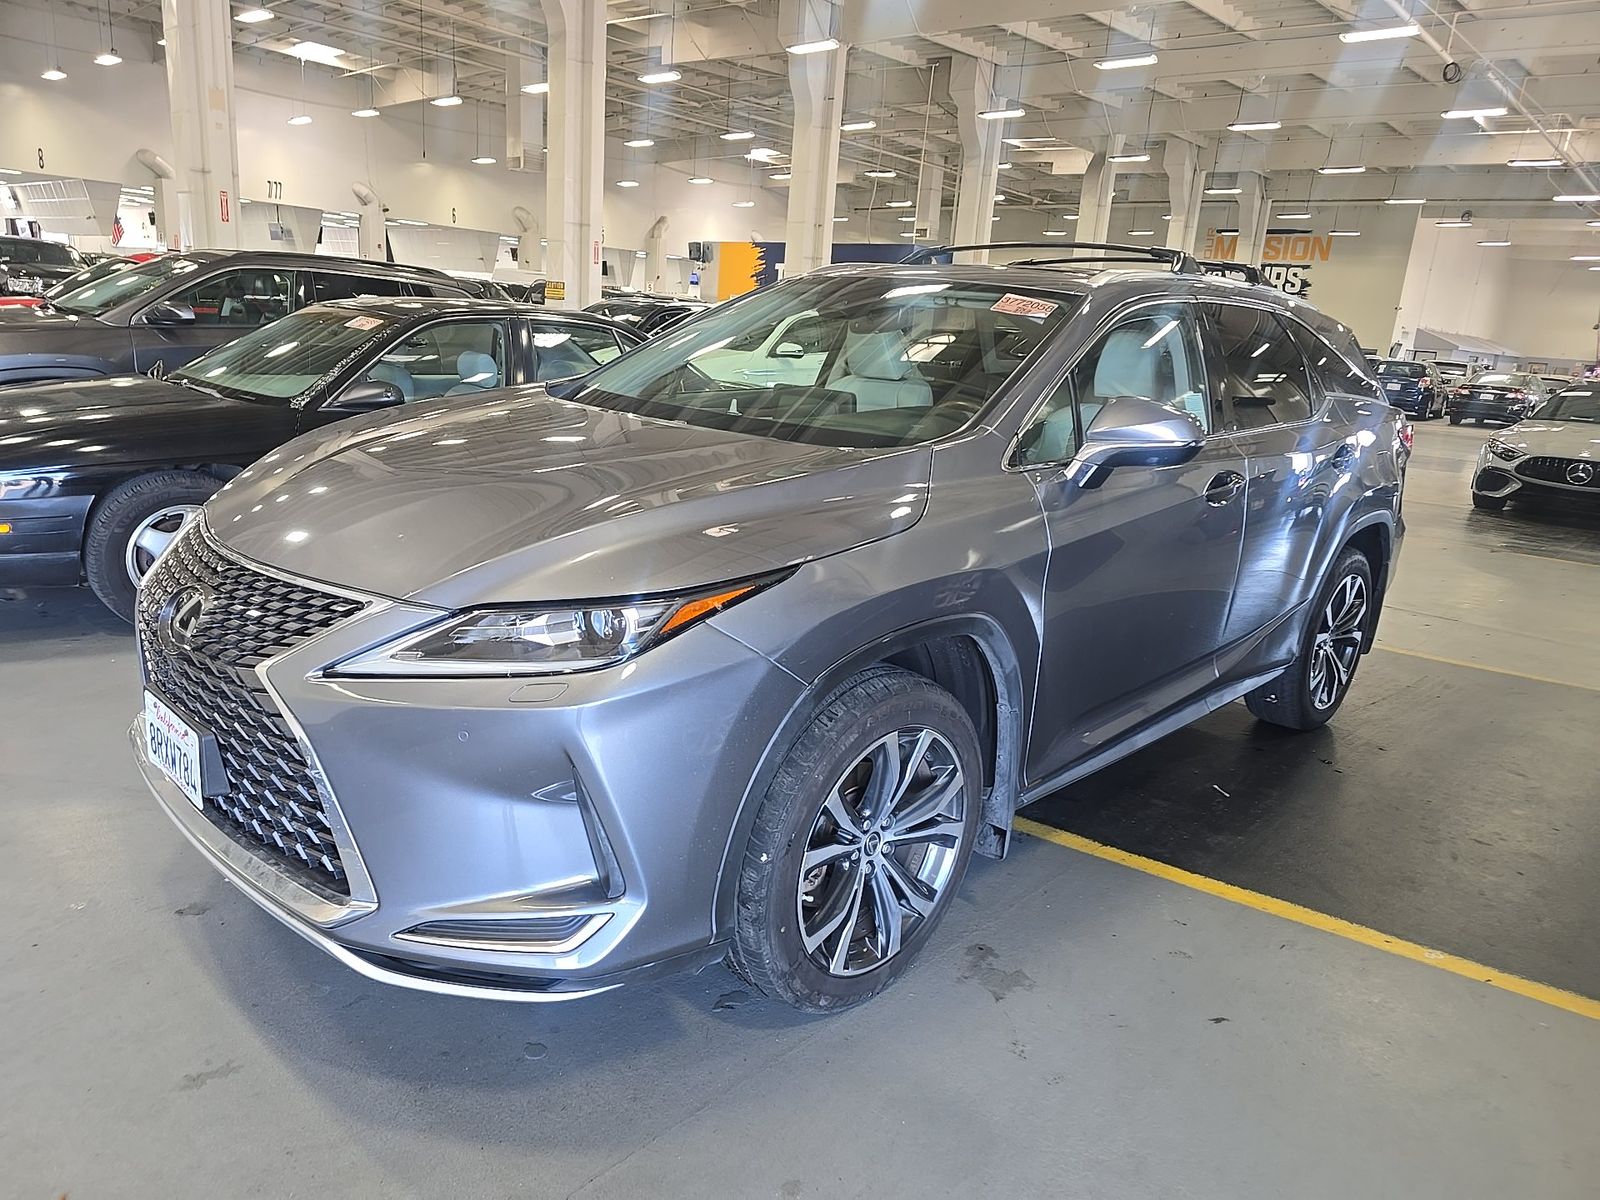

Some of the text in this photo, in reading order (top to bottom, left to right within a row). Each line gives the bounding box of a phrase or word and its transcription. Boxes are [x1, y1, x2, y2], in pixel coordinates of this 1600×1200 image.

[37, 147, 45, 170] 8
[451, 207, 457, 224] 6
[1213, 235, 1333, 262] MSION
[156, 704, 188, 740] California
